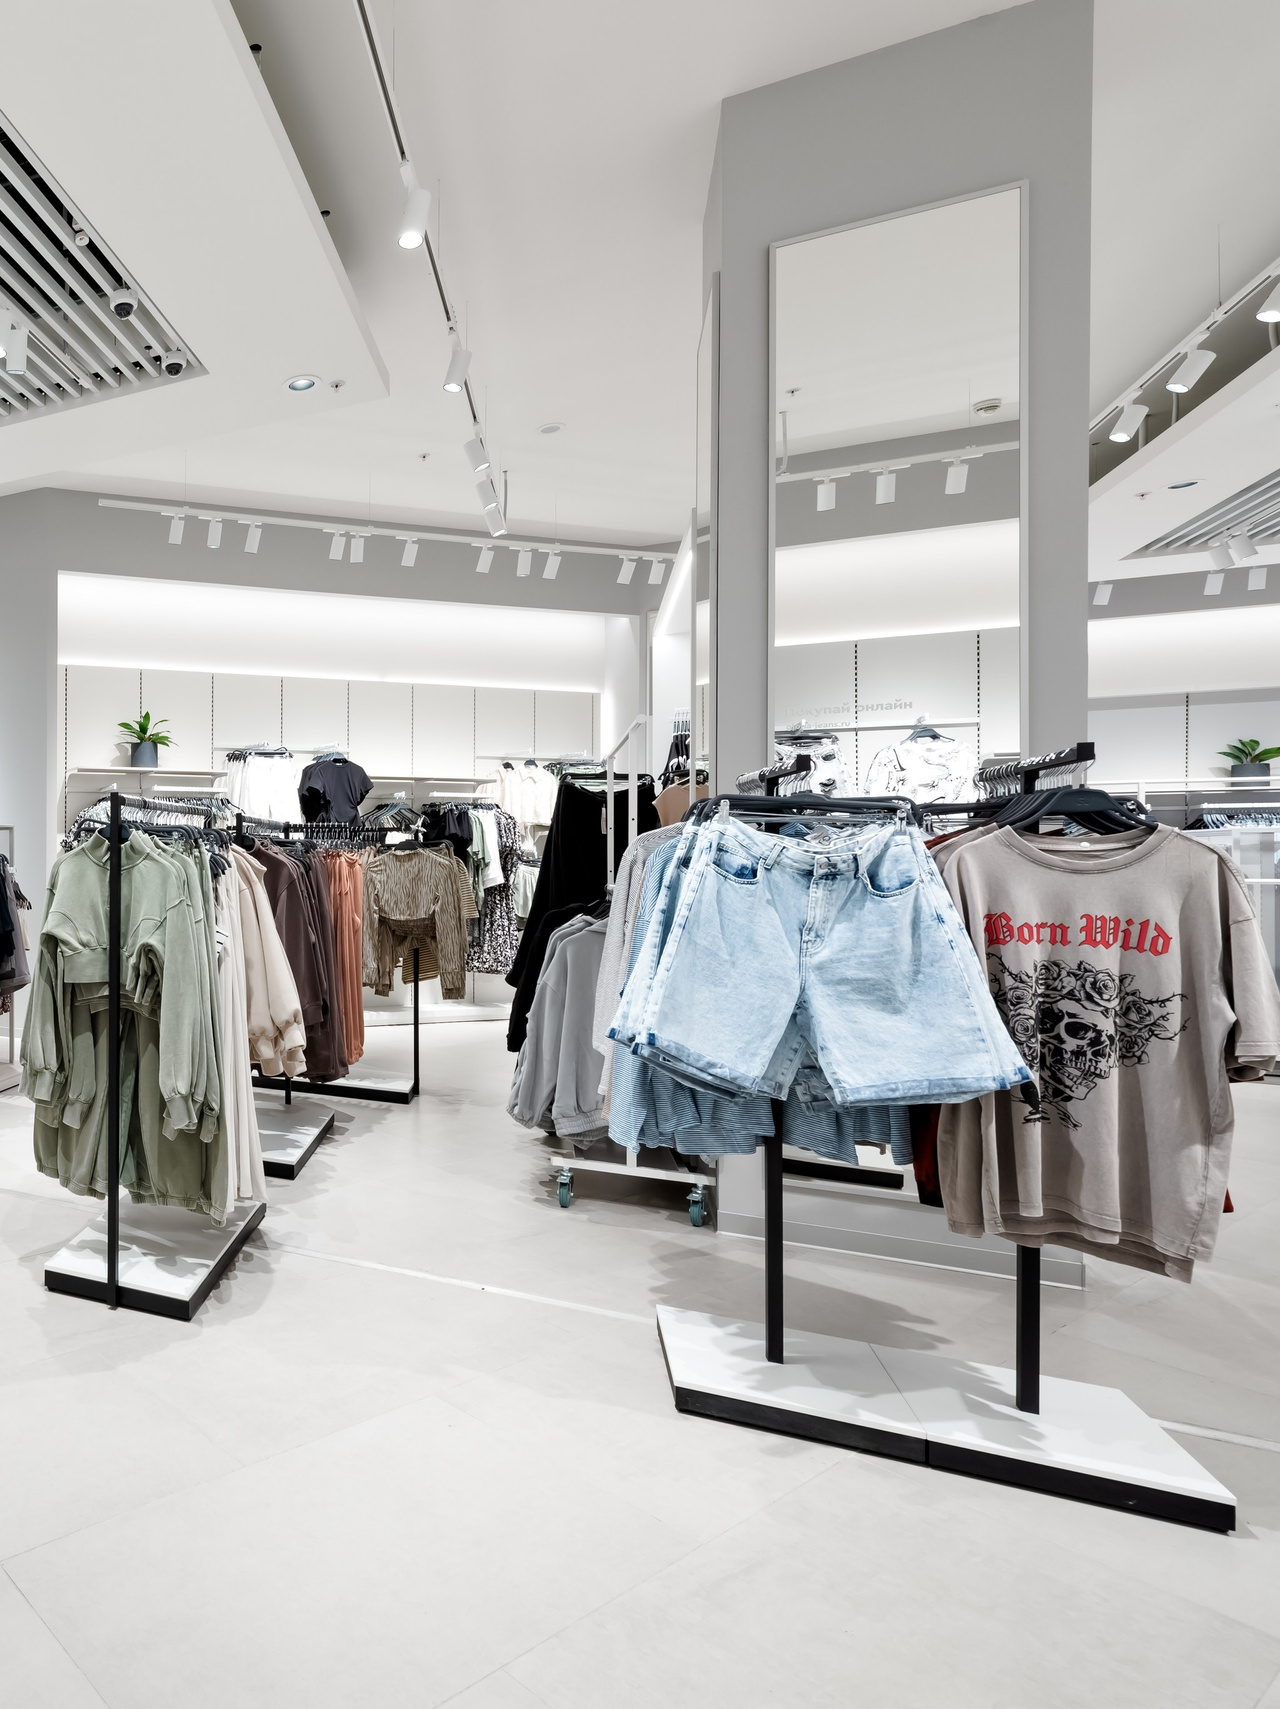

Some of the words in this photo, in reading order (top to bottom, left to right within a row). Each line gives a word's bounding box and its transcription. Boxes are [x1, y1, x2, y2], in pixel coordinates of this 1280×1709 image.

[856, 699, 913, 713] онлайн
[983, 911, 1072, 947] Born
[1080, 913, 1173, 957] Wild
